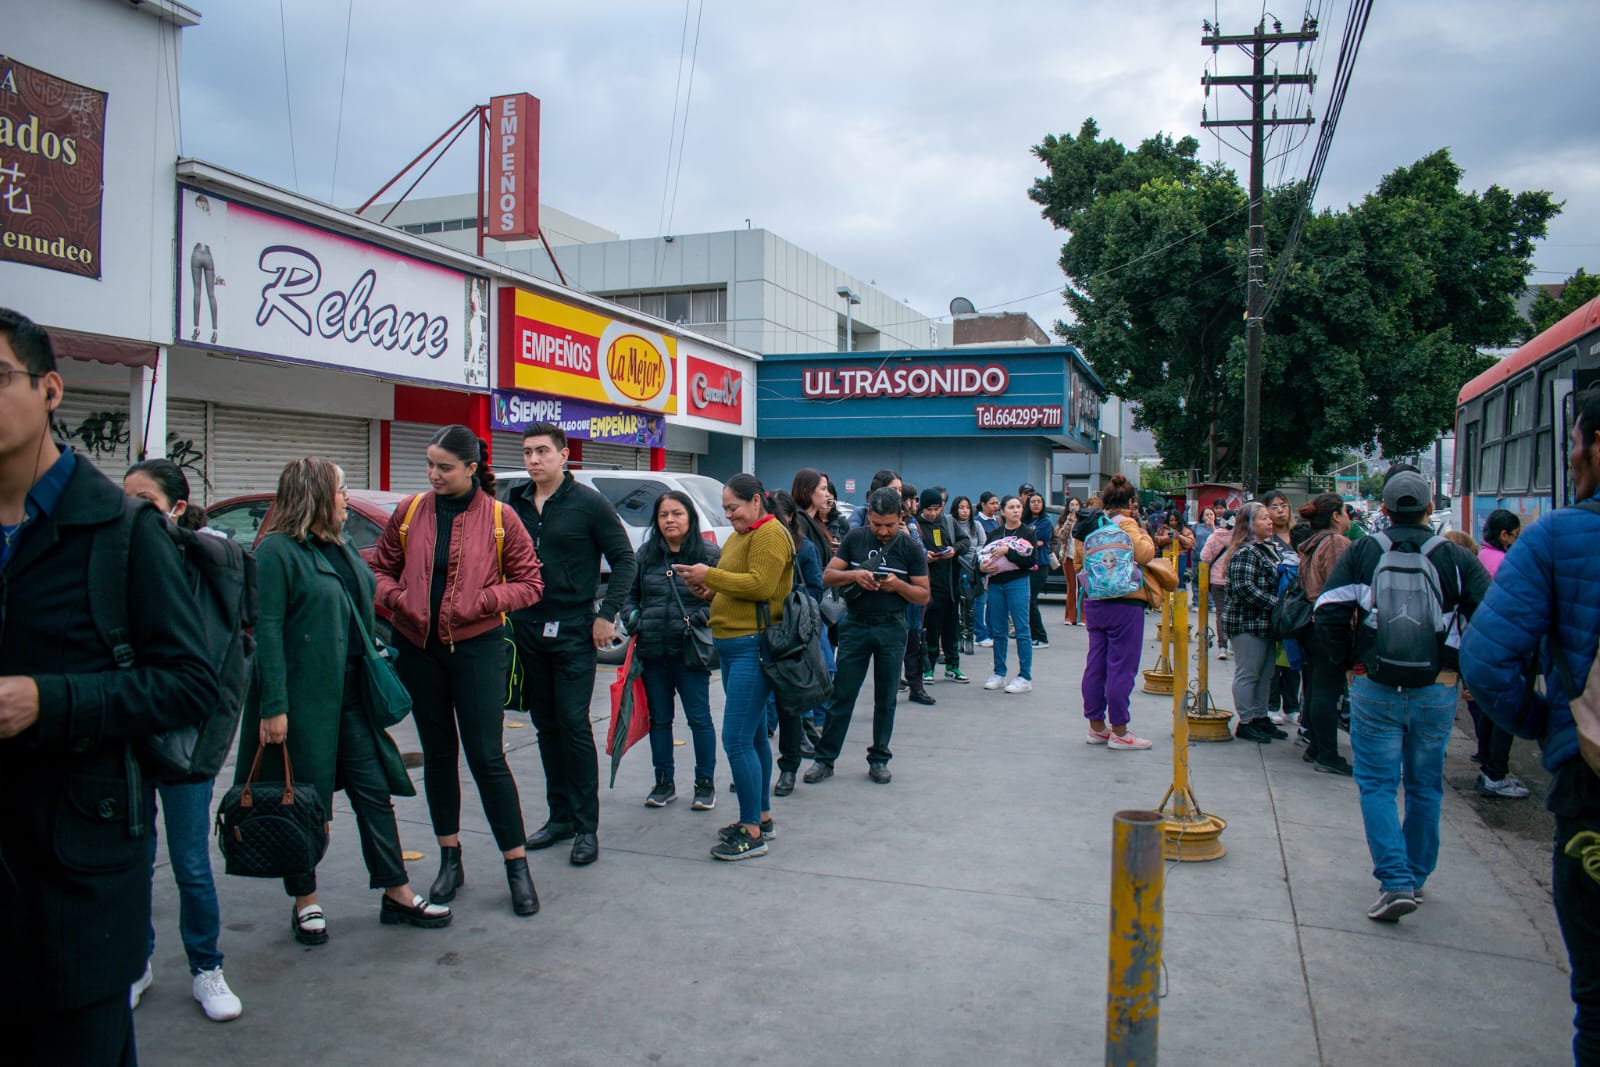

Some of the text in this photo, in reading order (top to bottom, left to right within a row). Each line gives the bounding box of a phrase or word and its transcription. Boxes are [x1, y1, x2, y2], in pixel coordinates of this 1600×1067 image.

[501, 98, 518, 231] EMPEÑOS
[0, 223, 93, 264] enudeo
[256, 245, 449, 359] Rebane
[522, 329, 592, 373] EMPEÑOS
[611, 342, 625, 381] La
[627, 347, 662, 397] Mejor!
[804, 367, 1005, 395] ULTRASONIDO
[590, 411, 638, 438] EMPEÑAR
